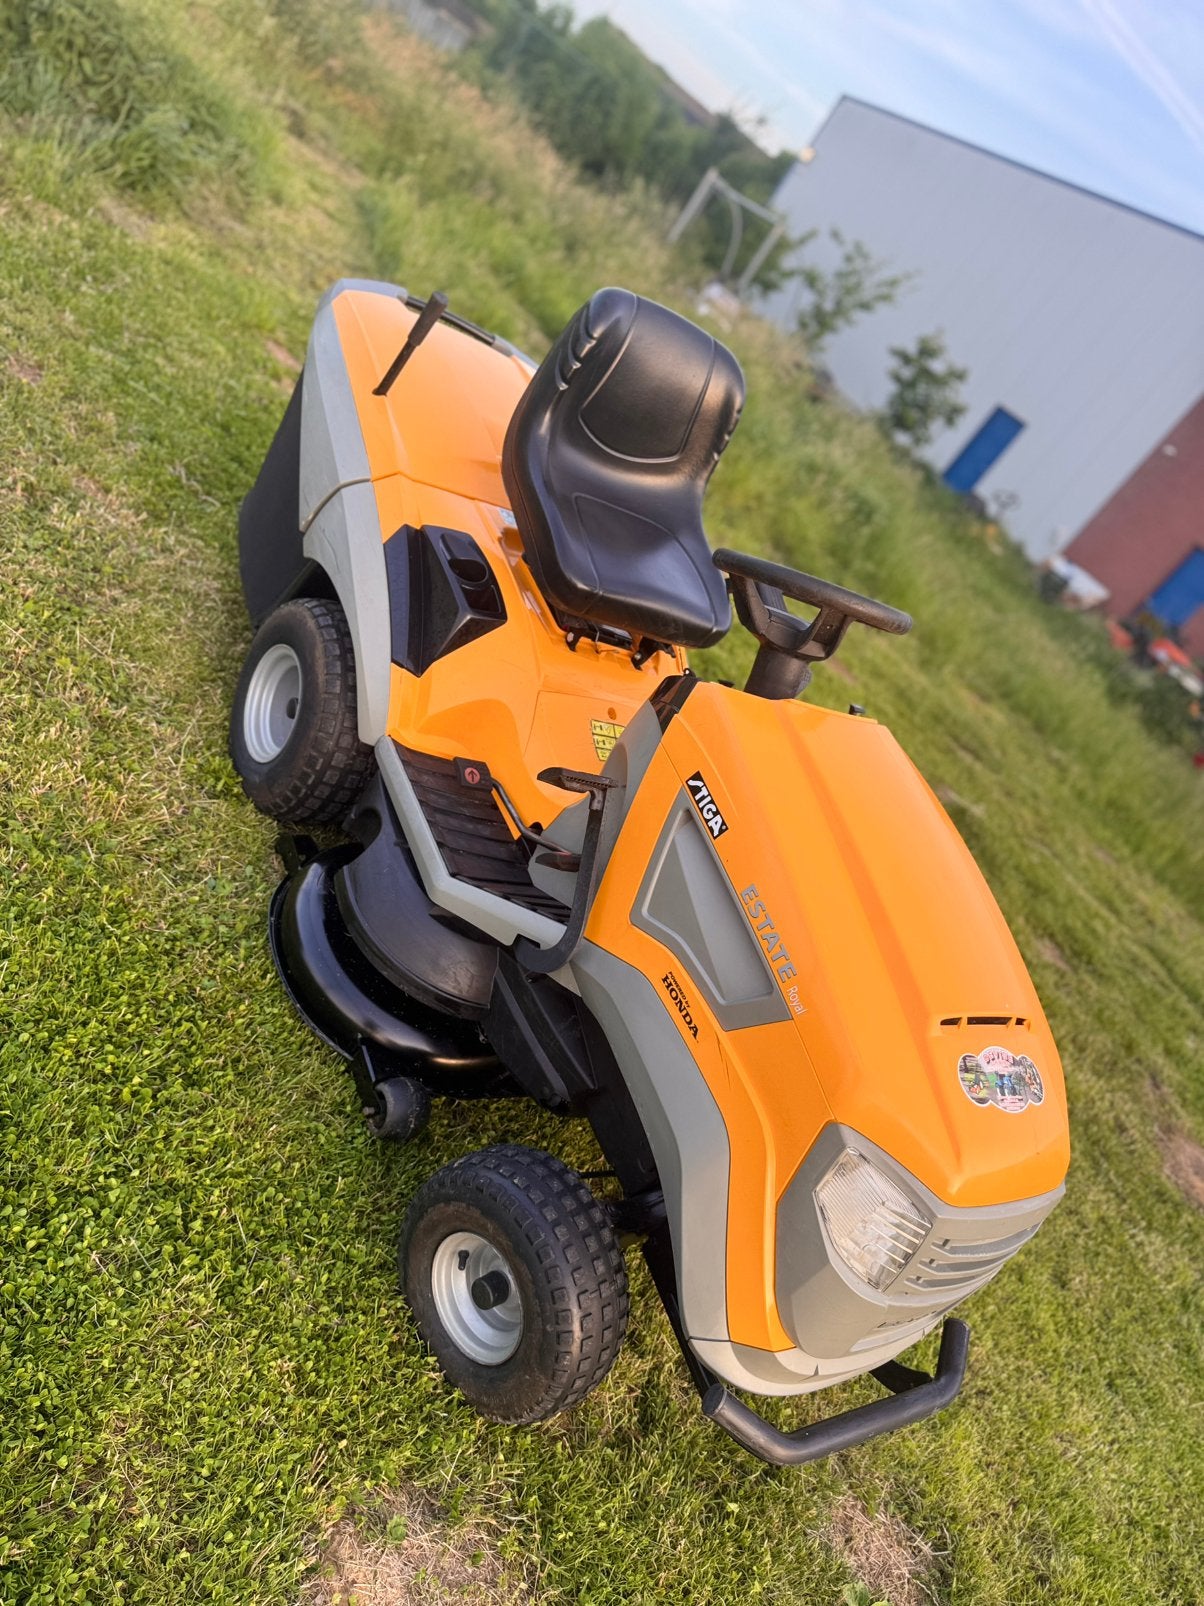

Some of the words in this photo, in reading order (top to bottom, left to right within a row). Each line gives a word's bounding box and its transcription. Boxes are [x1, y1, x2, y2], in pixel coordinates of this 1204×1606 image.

[687, 779, 724, 837] STIGA
[741, 884, 797, 983] ESTATE
[787, 985, 807, 1015] Royal
[661, 973, 700, 1039] HONDA
[667, 971, 686, 1000] POWERED
